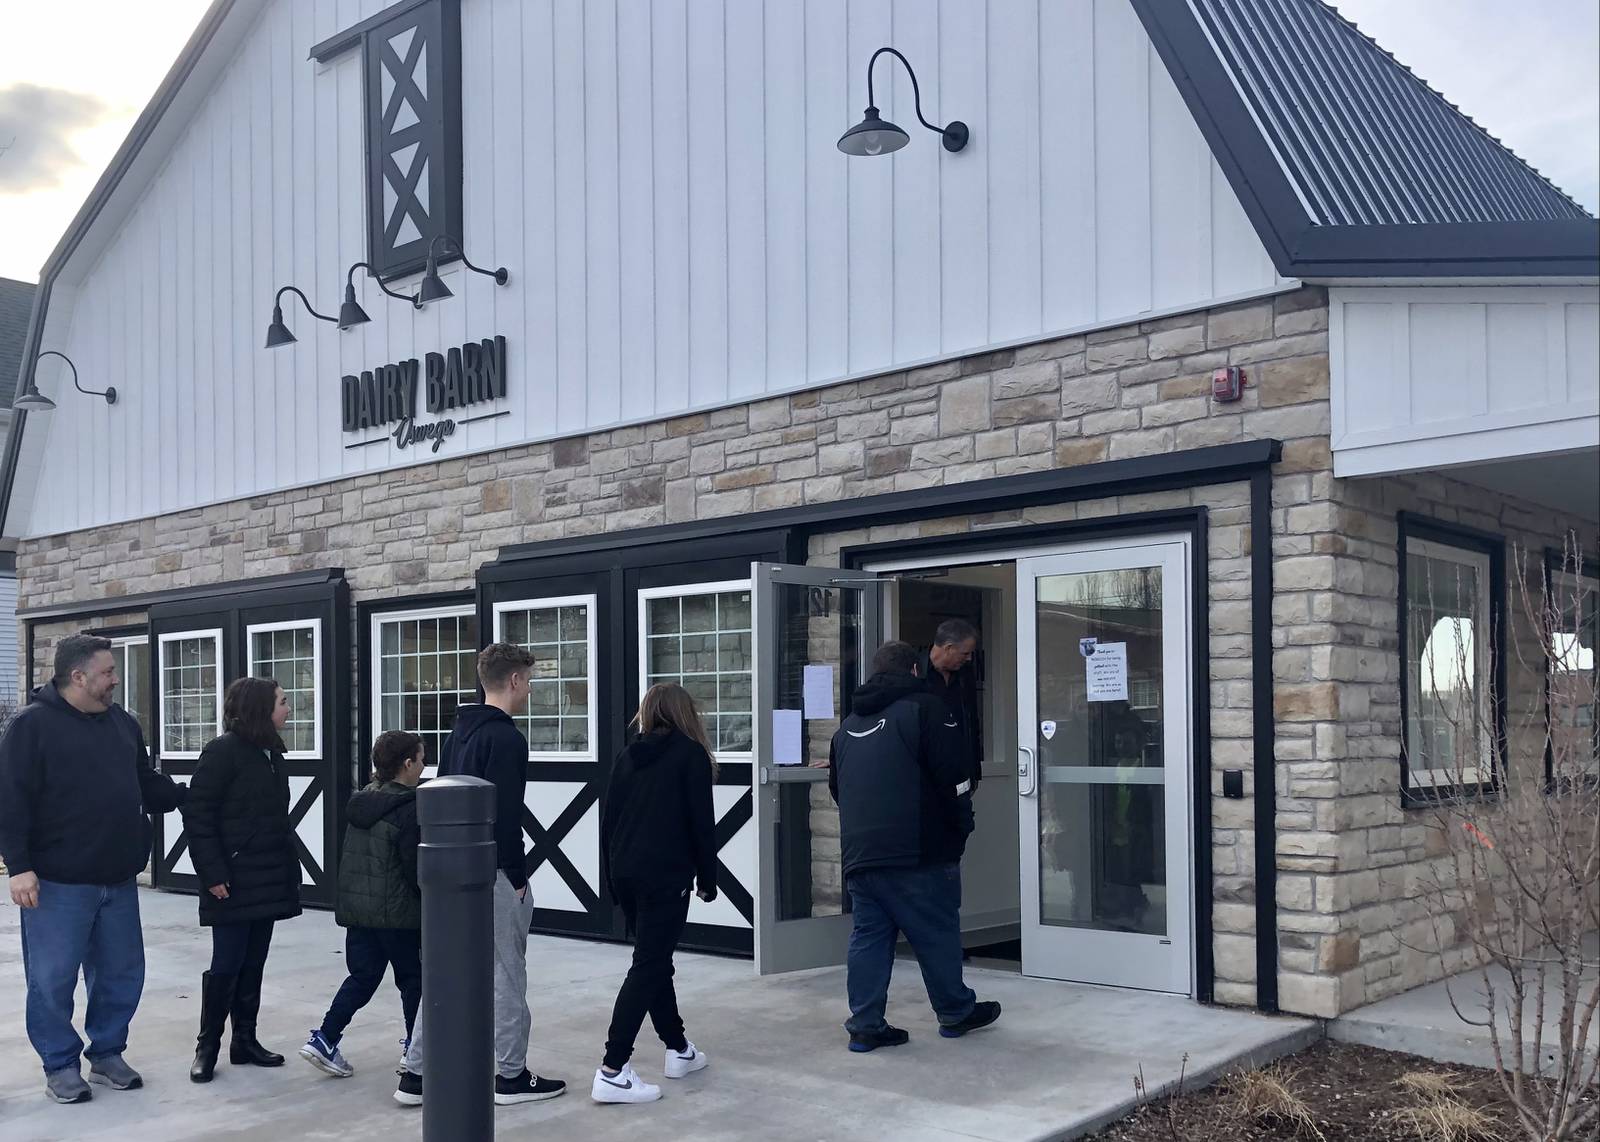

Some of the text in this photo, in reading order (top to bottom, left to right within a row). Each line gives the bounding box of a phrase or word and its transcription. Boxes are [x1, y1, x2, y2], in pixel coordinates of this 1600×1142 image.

[341, 335, 506, 432] DAIRY BARN
[392, 416, 456, 453] Oswego
